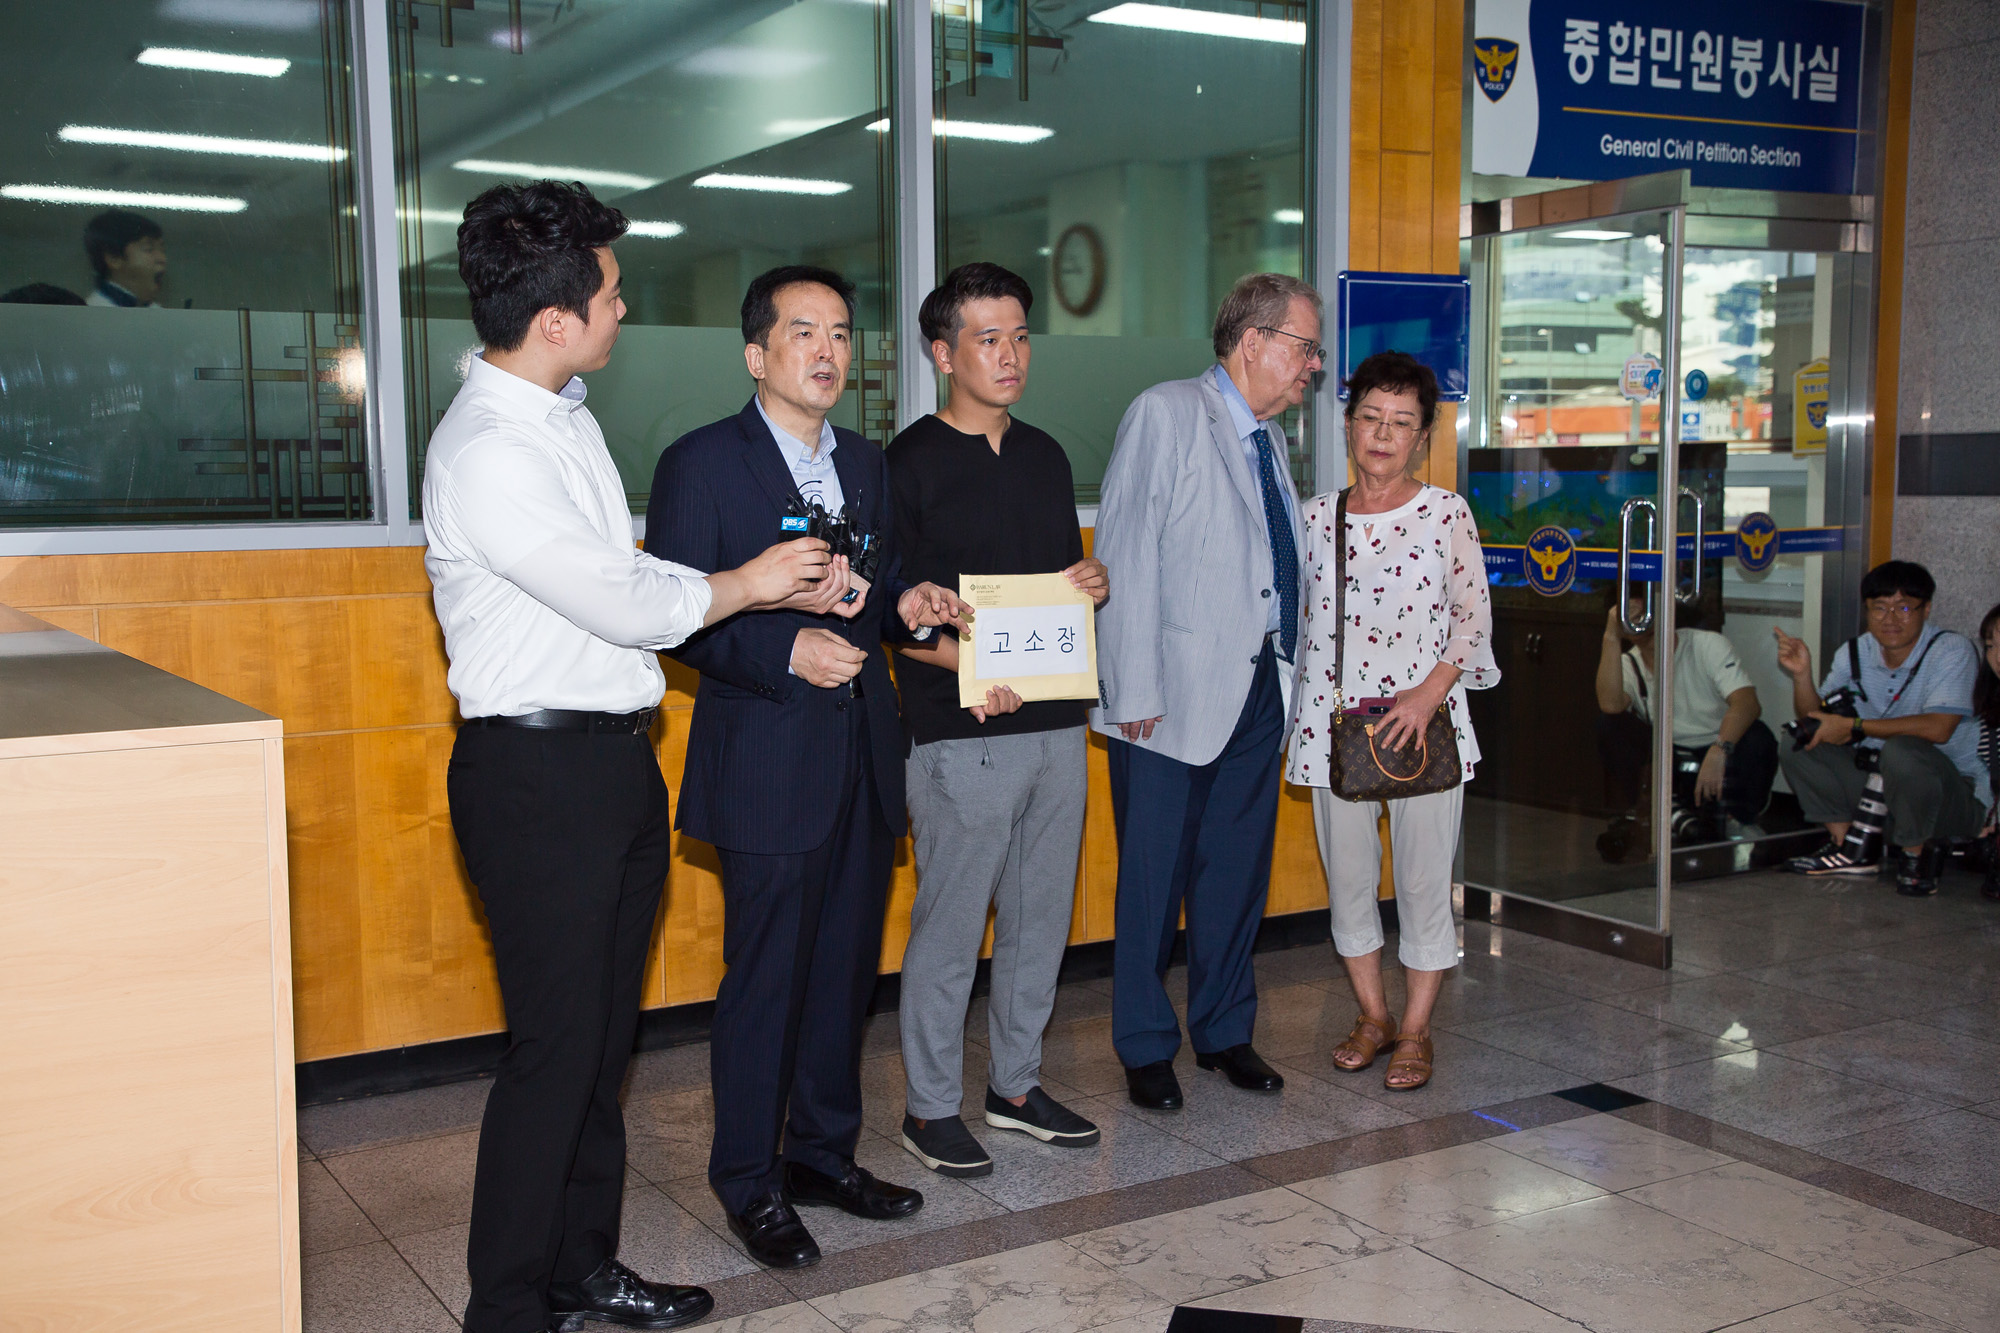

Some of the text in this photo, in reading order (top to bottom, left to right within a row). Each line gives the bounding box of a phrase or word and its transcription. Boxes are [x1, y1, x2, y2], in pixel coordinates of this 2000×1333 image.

[1563, 18, 1839, 102] 종합민원봉사실
[1484, 82, 1505, 91] POLICE
[1600, 134, 1801, 167] General Civil Petition Section
[783, 518, 798, 526] OBS
